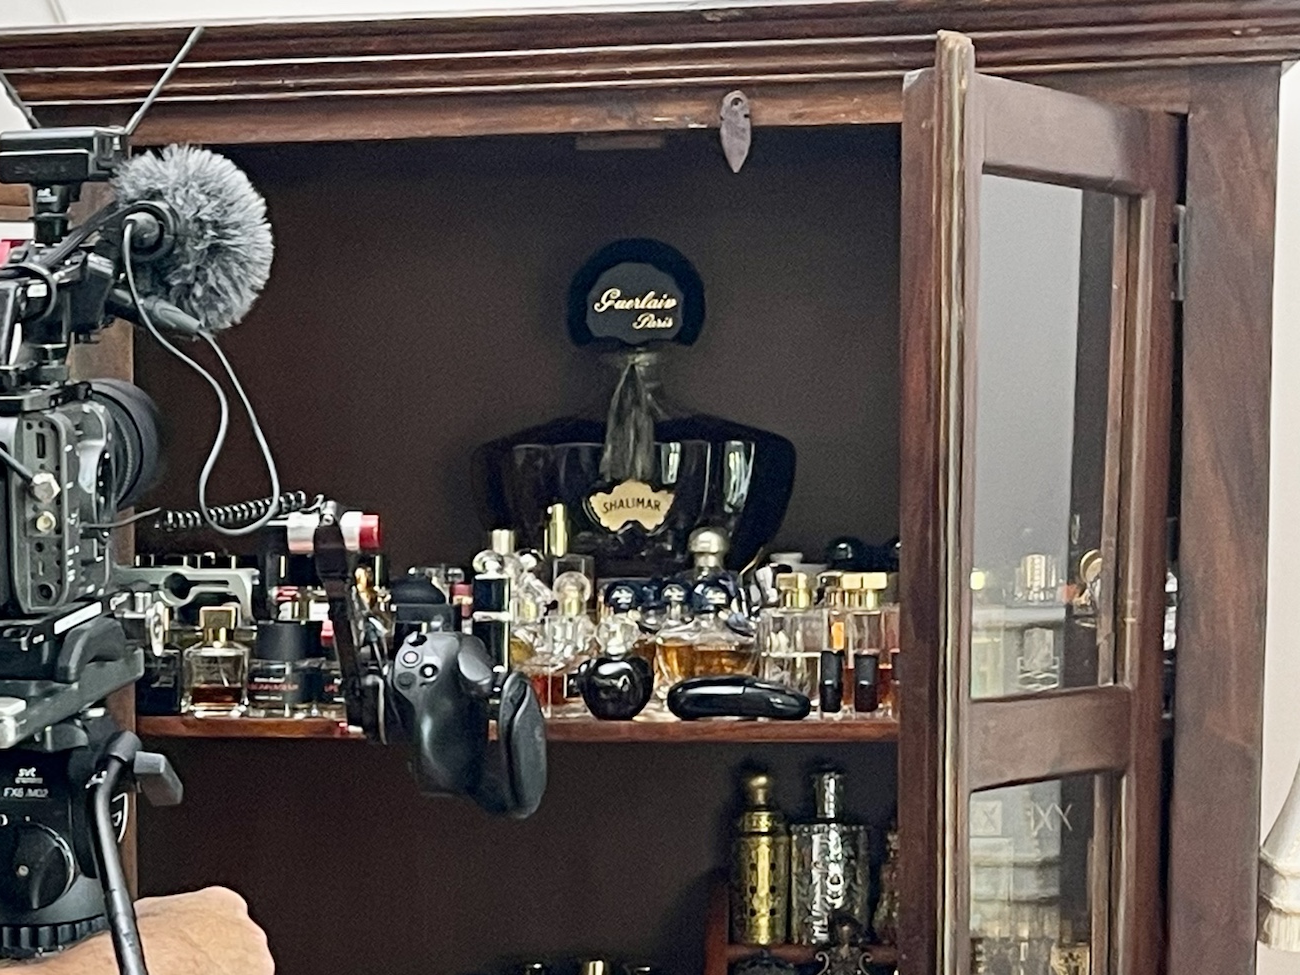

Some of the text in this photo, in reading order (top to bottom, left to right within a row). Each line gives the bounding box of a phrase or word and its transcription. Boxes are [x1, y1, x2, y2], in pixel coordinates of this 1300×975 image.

[593, 287, 677, 313] Guerlain
[632, 312, 673, 330] Paris
[602, 497, 661, 514] SHALIMAR
[18, 766, 37, 778] svt
[3, 787, 24, 798] FX6
